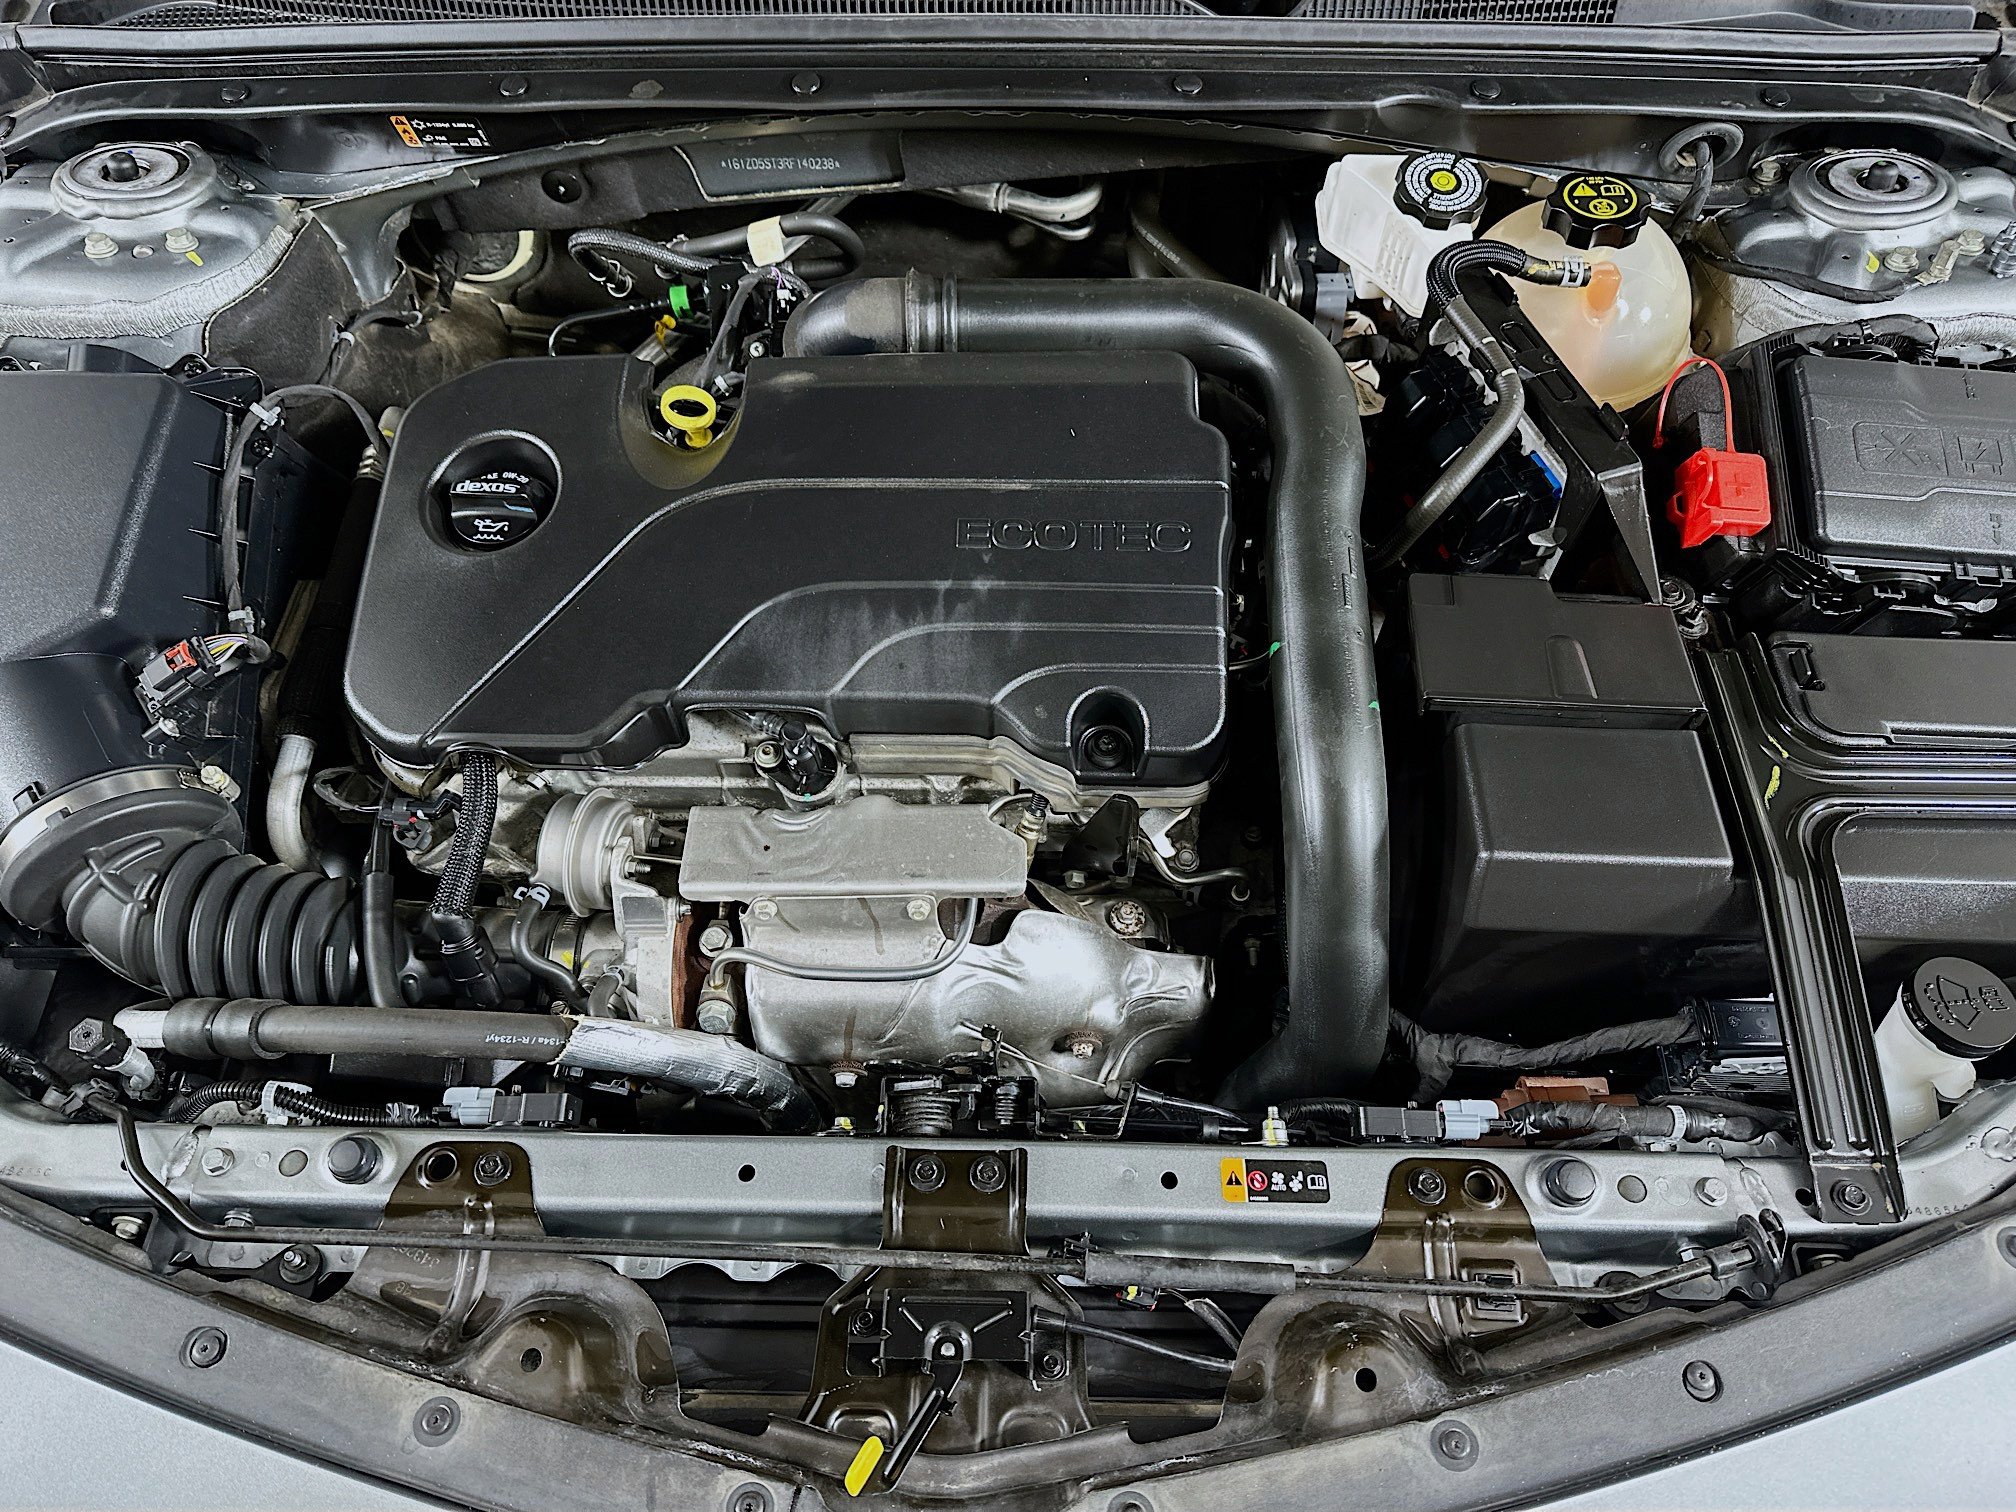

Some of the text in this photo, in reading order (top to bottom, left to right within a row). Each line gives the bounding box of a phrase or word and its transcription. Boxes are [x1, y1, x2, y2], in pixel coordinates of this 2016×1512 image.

[502, 472, 530, 484] 0W-20
[455, 480, 520, 493] dexos
[956, 517, 1192, 552] ECOTEC
[485, 1033, 529, 1045] R-1234yf
[537, 1037, 566, 1046] -134a
